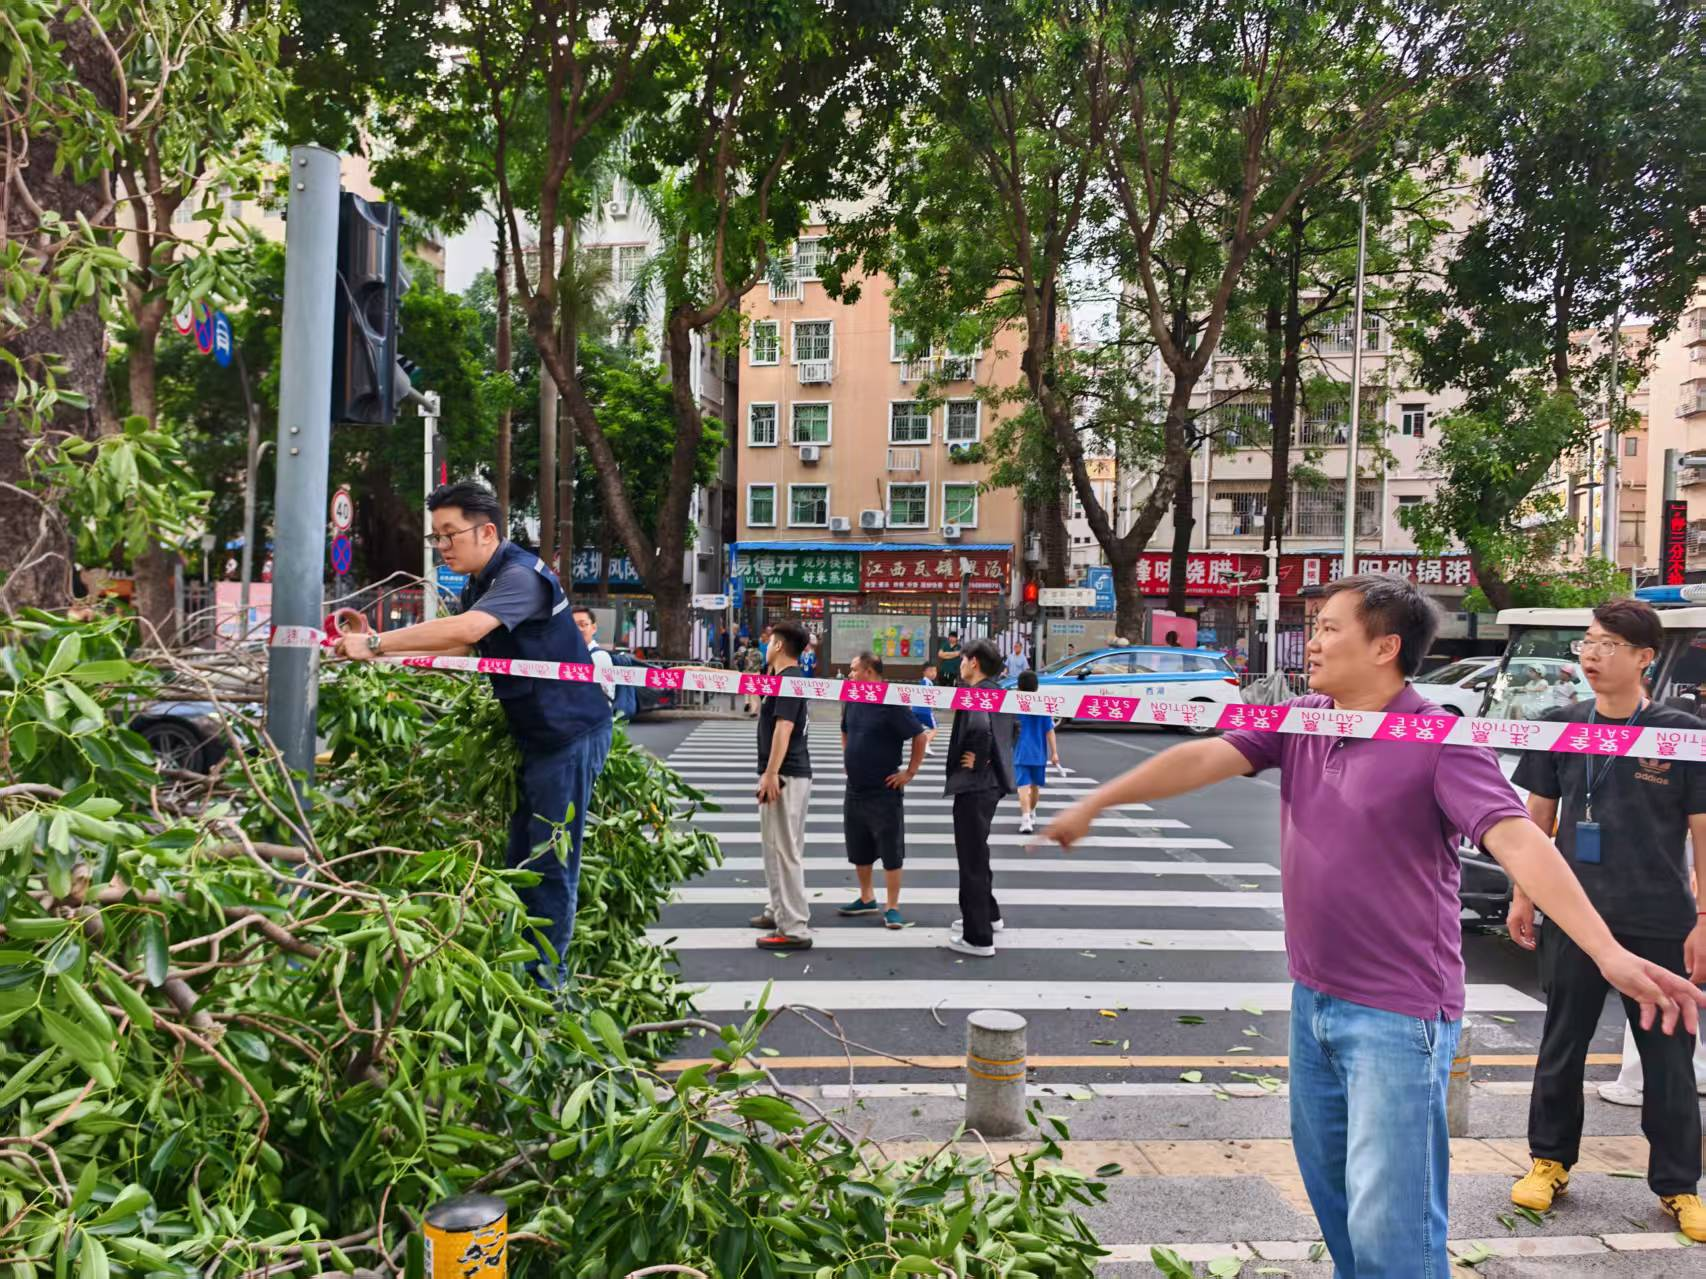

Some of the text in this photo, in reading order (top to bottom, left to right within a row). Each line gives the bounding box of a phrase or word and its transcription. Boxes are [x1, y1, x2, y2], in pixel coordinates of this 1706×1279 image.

[336, 502, 349, 519] 40
[692, 674, 728, 682] CAUTION
[749, 677, 776, 685] SAFE
[791, 679, 830, 688] CAUTION
[696, 680, 726, 690] 注意
[745, 683, 772, 693] 安全
[851, 682, 881, 691] SAFE
[794, 688, 827, 697] 注意
[848, 689, 878, 700] 安全
[966, 689, 998, 699] SAFE
[900, 693, 936, 705] 注意
[960, 697, 993, 709] 安全
[1016, 694, 1064, 703] CAUTION
[1092, 699, 1130, 708] SAFE
[1018, 701, 1059, 714] 注意
[1086, 705, 1124, 718] 安全
[1150, 702, 1204, 712] CAUTION
[1152, 710, 1198, 724] 注意
[1235, 708, 1278, 718] SAFE
[1302, 712, 1362, 722] CAUTION
[1229, 715, 1270, 729] 安全
[1304, 721, 1352, 734] 注意
[1396, 717, 1445, 729] SAFE
[1389, 724, 1435, 740] 安全
[1472, 722, 1540, 734] CAUTION
[1579, 728, 1629, 739] SAFE
[1472, 732, 1528, 746] 注意
[1570, 736, 1618, 752] 安全
